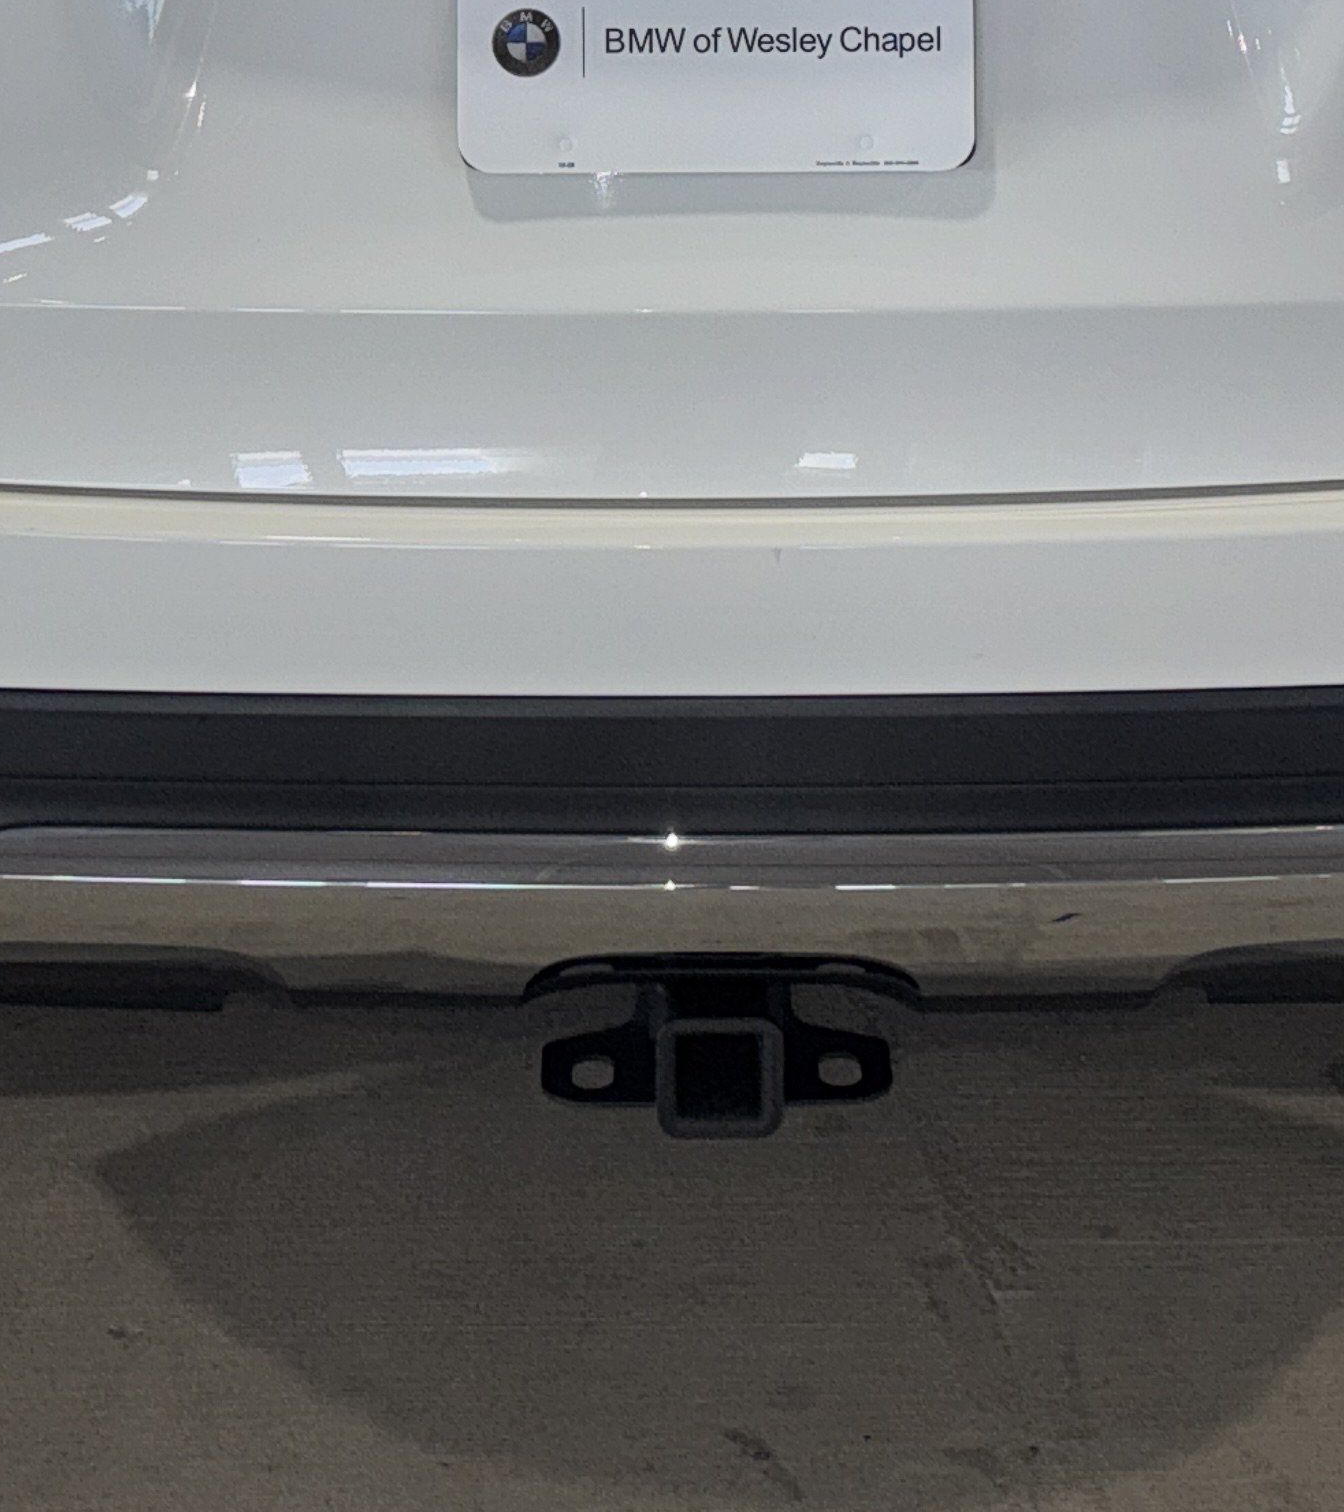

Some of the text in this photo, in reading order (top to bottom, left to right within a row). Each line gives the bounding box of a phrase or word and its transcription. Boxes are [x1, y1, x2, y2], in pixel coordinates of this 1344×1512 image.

[499, 11, 554, 33] BMW
[604, 25, 942, 60] BMW of Wesley Chapel
